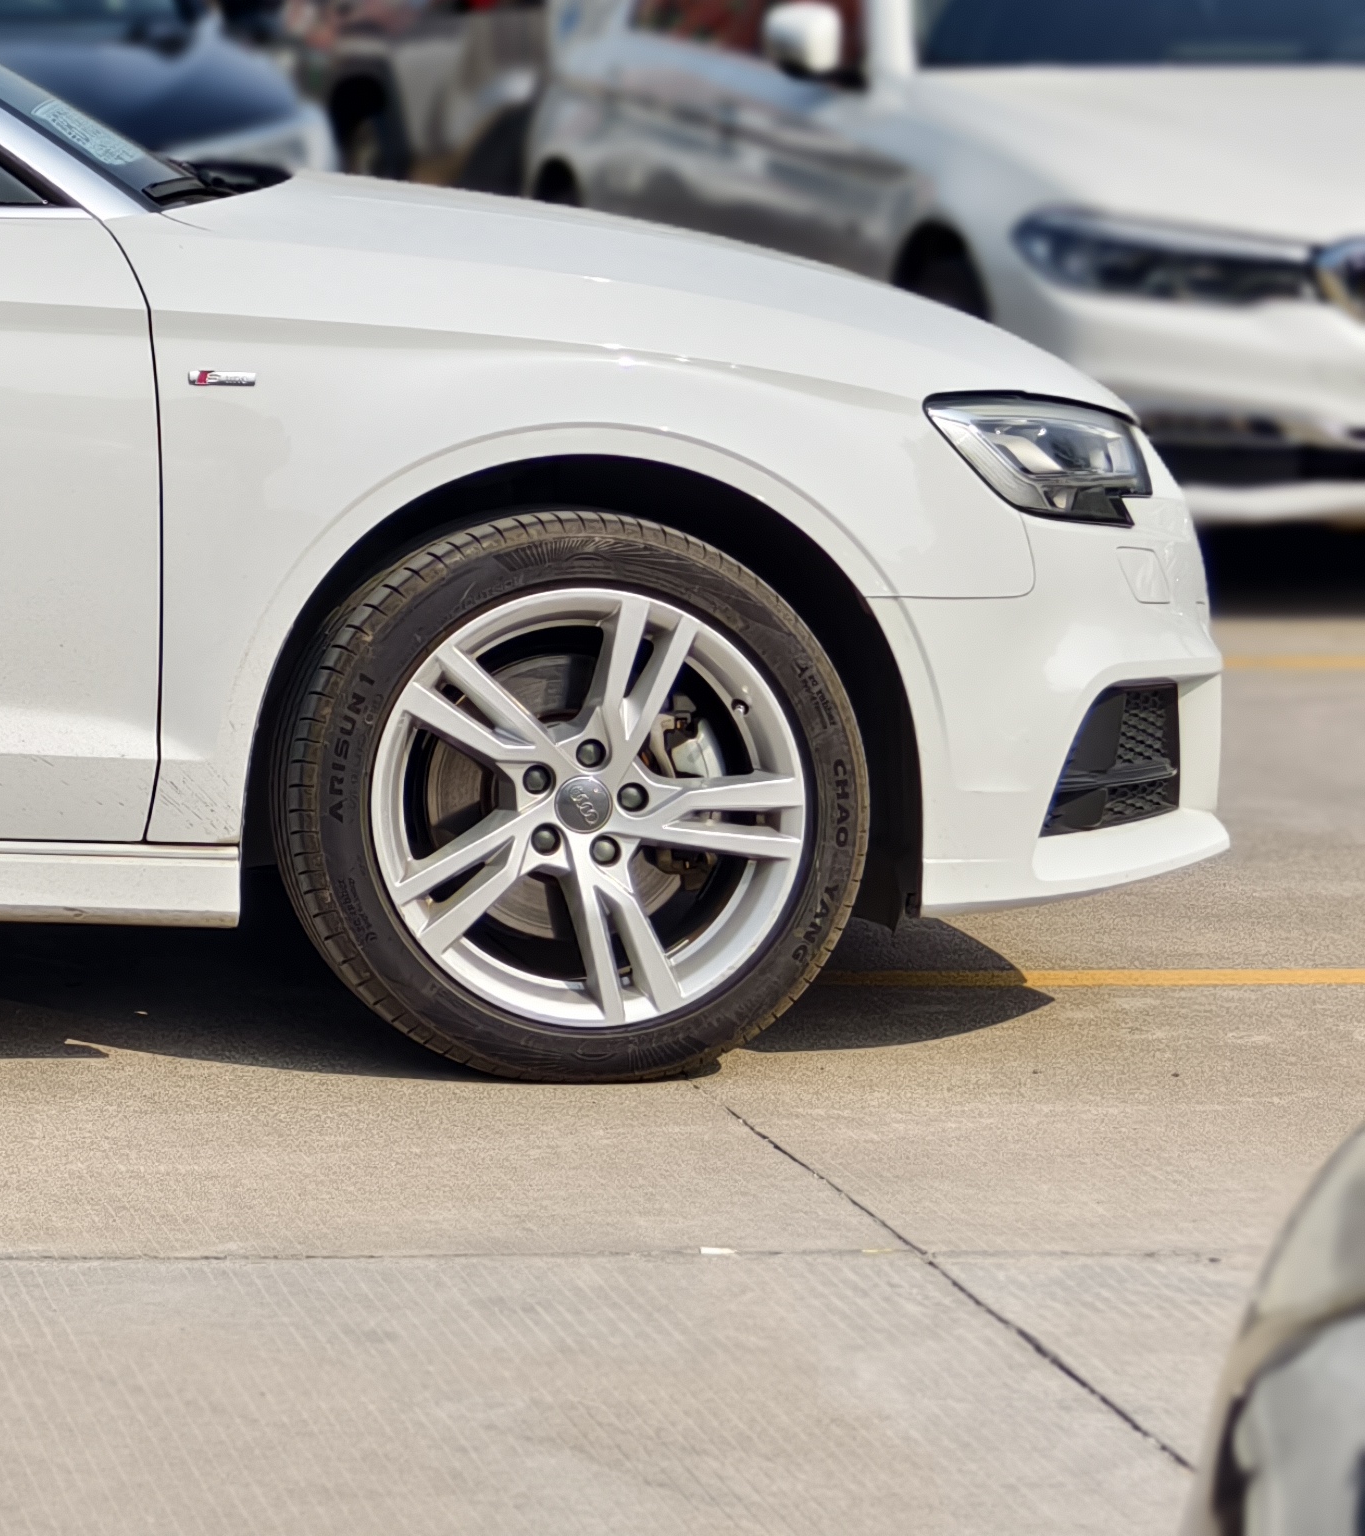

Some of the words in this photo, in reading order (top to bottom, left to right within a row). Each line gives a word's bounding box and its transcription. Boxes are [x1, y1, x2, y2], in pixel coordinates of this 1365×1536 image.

[329, 692, 366, 824] ARISUN
[833, 758, 850, 848] CHAO
[791, 884, 840, 965] YANG
